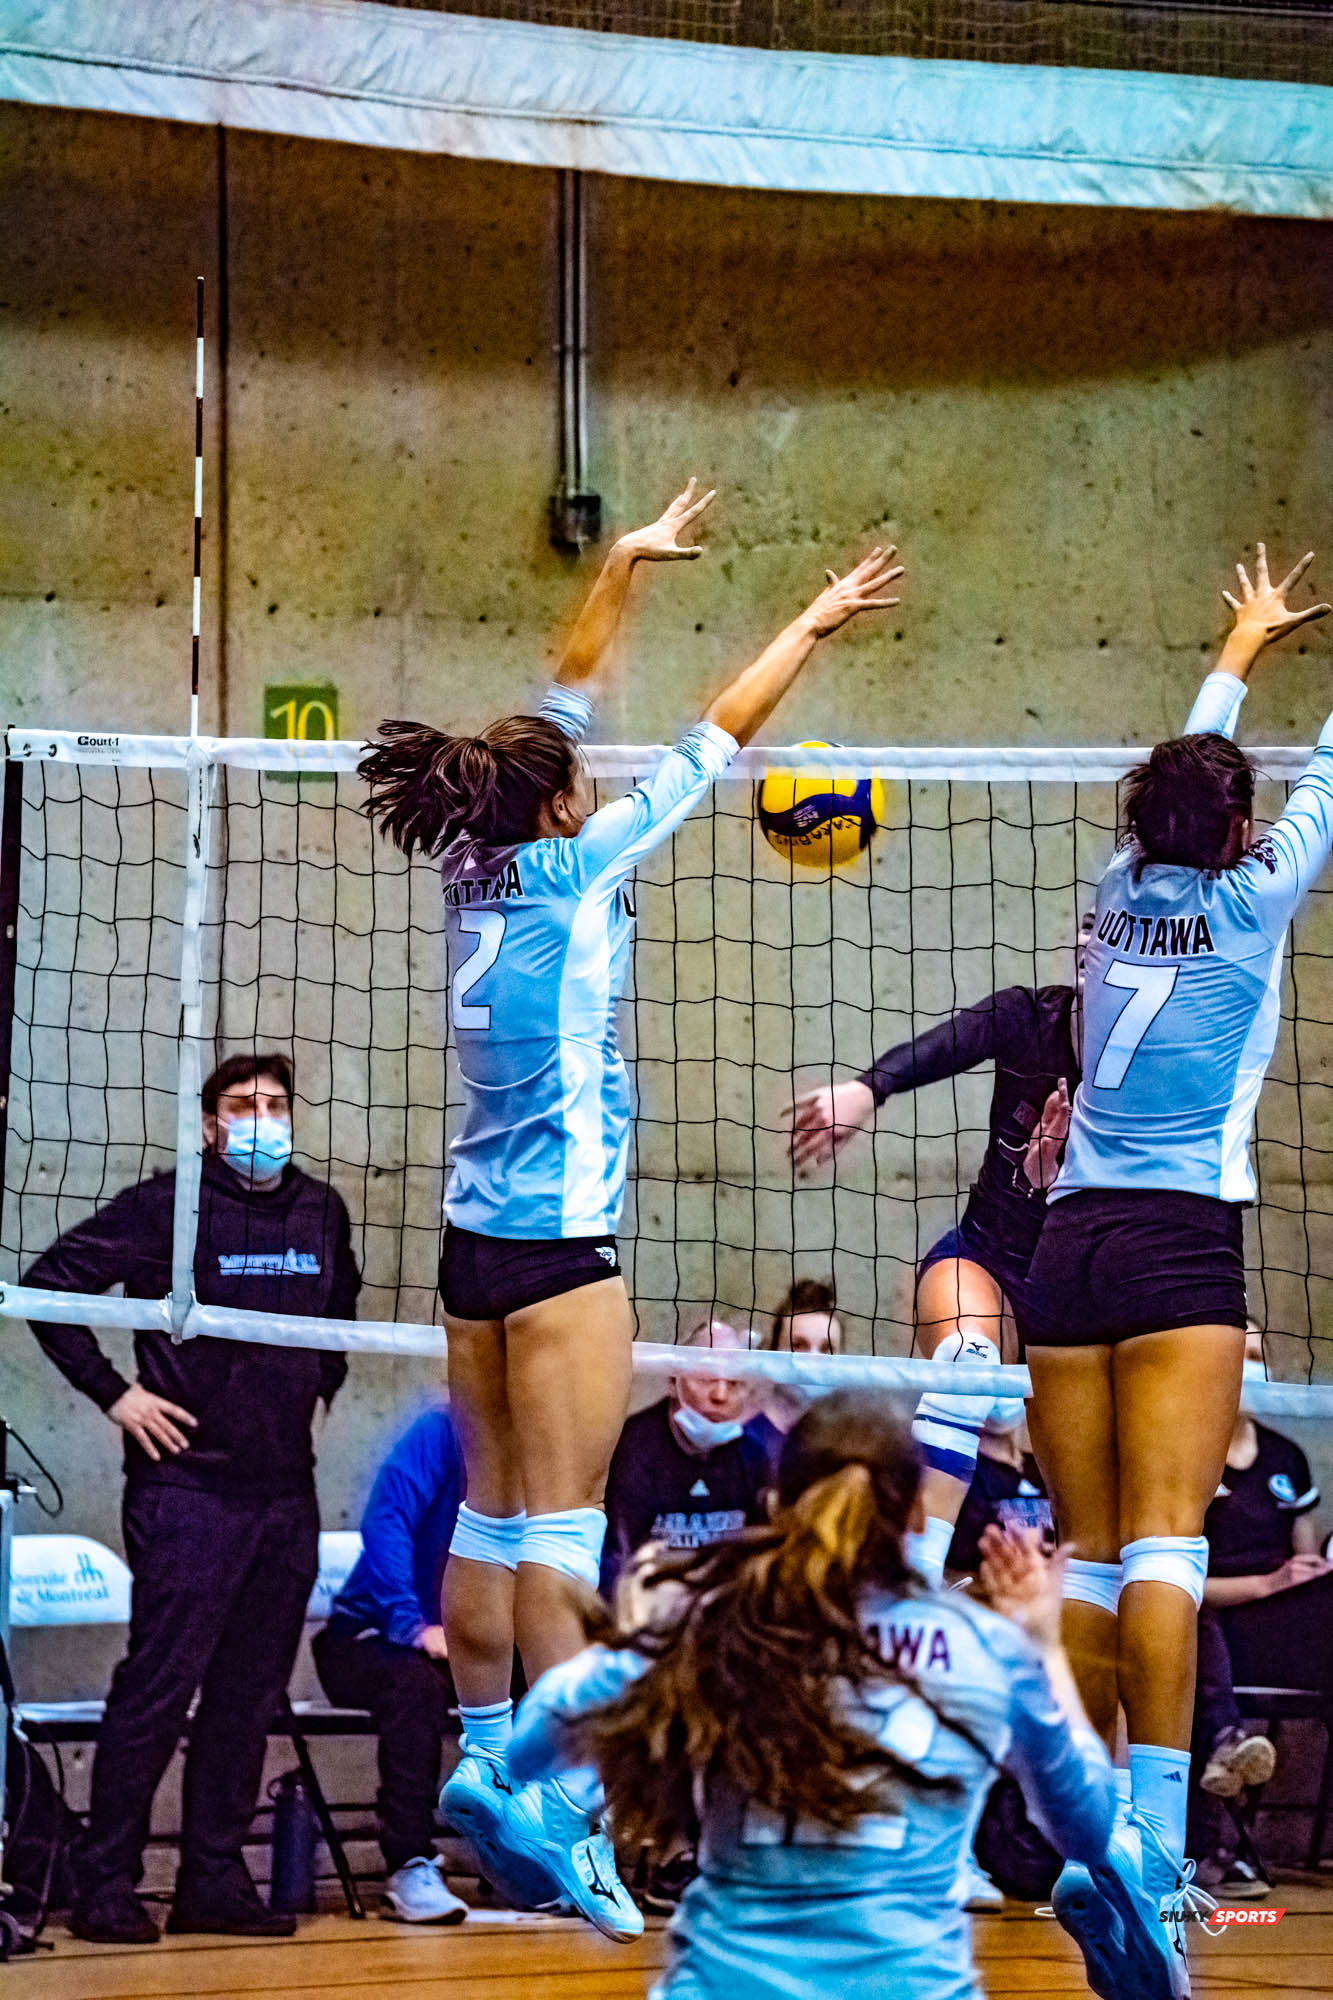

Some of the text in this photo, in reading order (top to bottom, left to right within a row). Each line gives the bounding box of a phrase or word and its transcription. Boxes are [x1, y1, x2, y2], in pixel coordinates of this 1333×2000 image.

[452, 908, 508, 1031] 2
[1098, 909, 1216, 956] UOTTAWA
[1092, 958, 1181, 1091] 7
